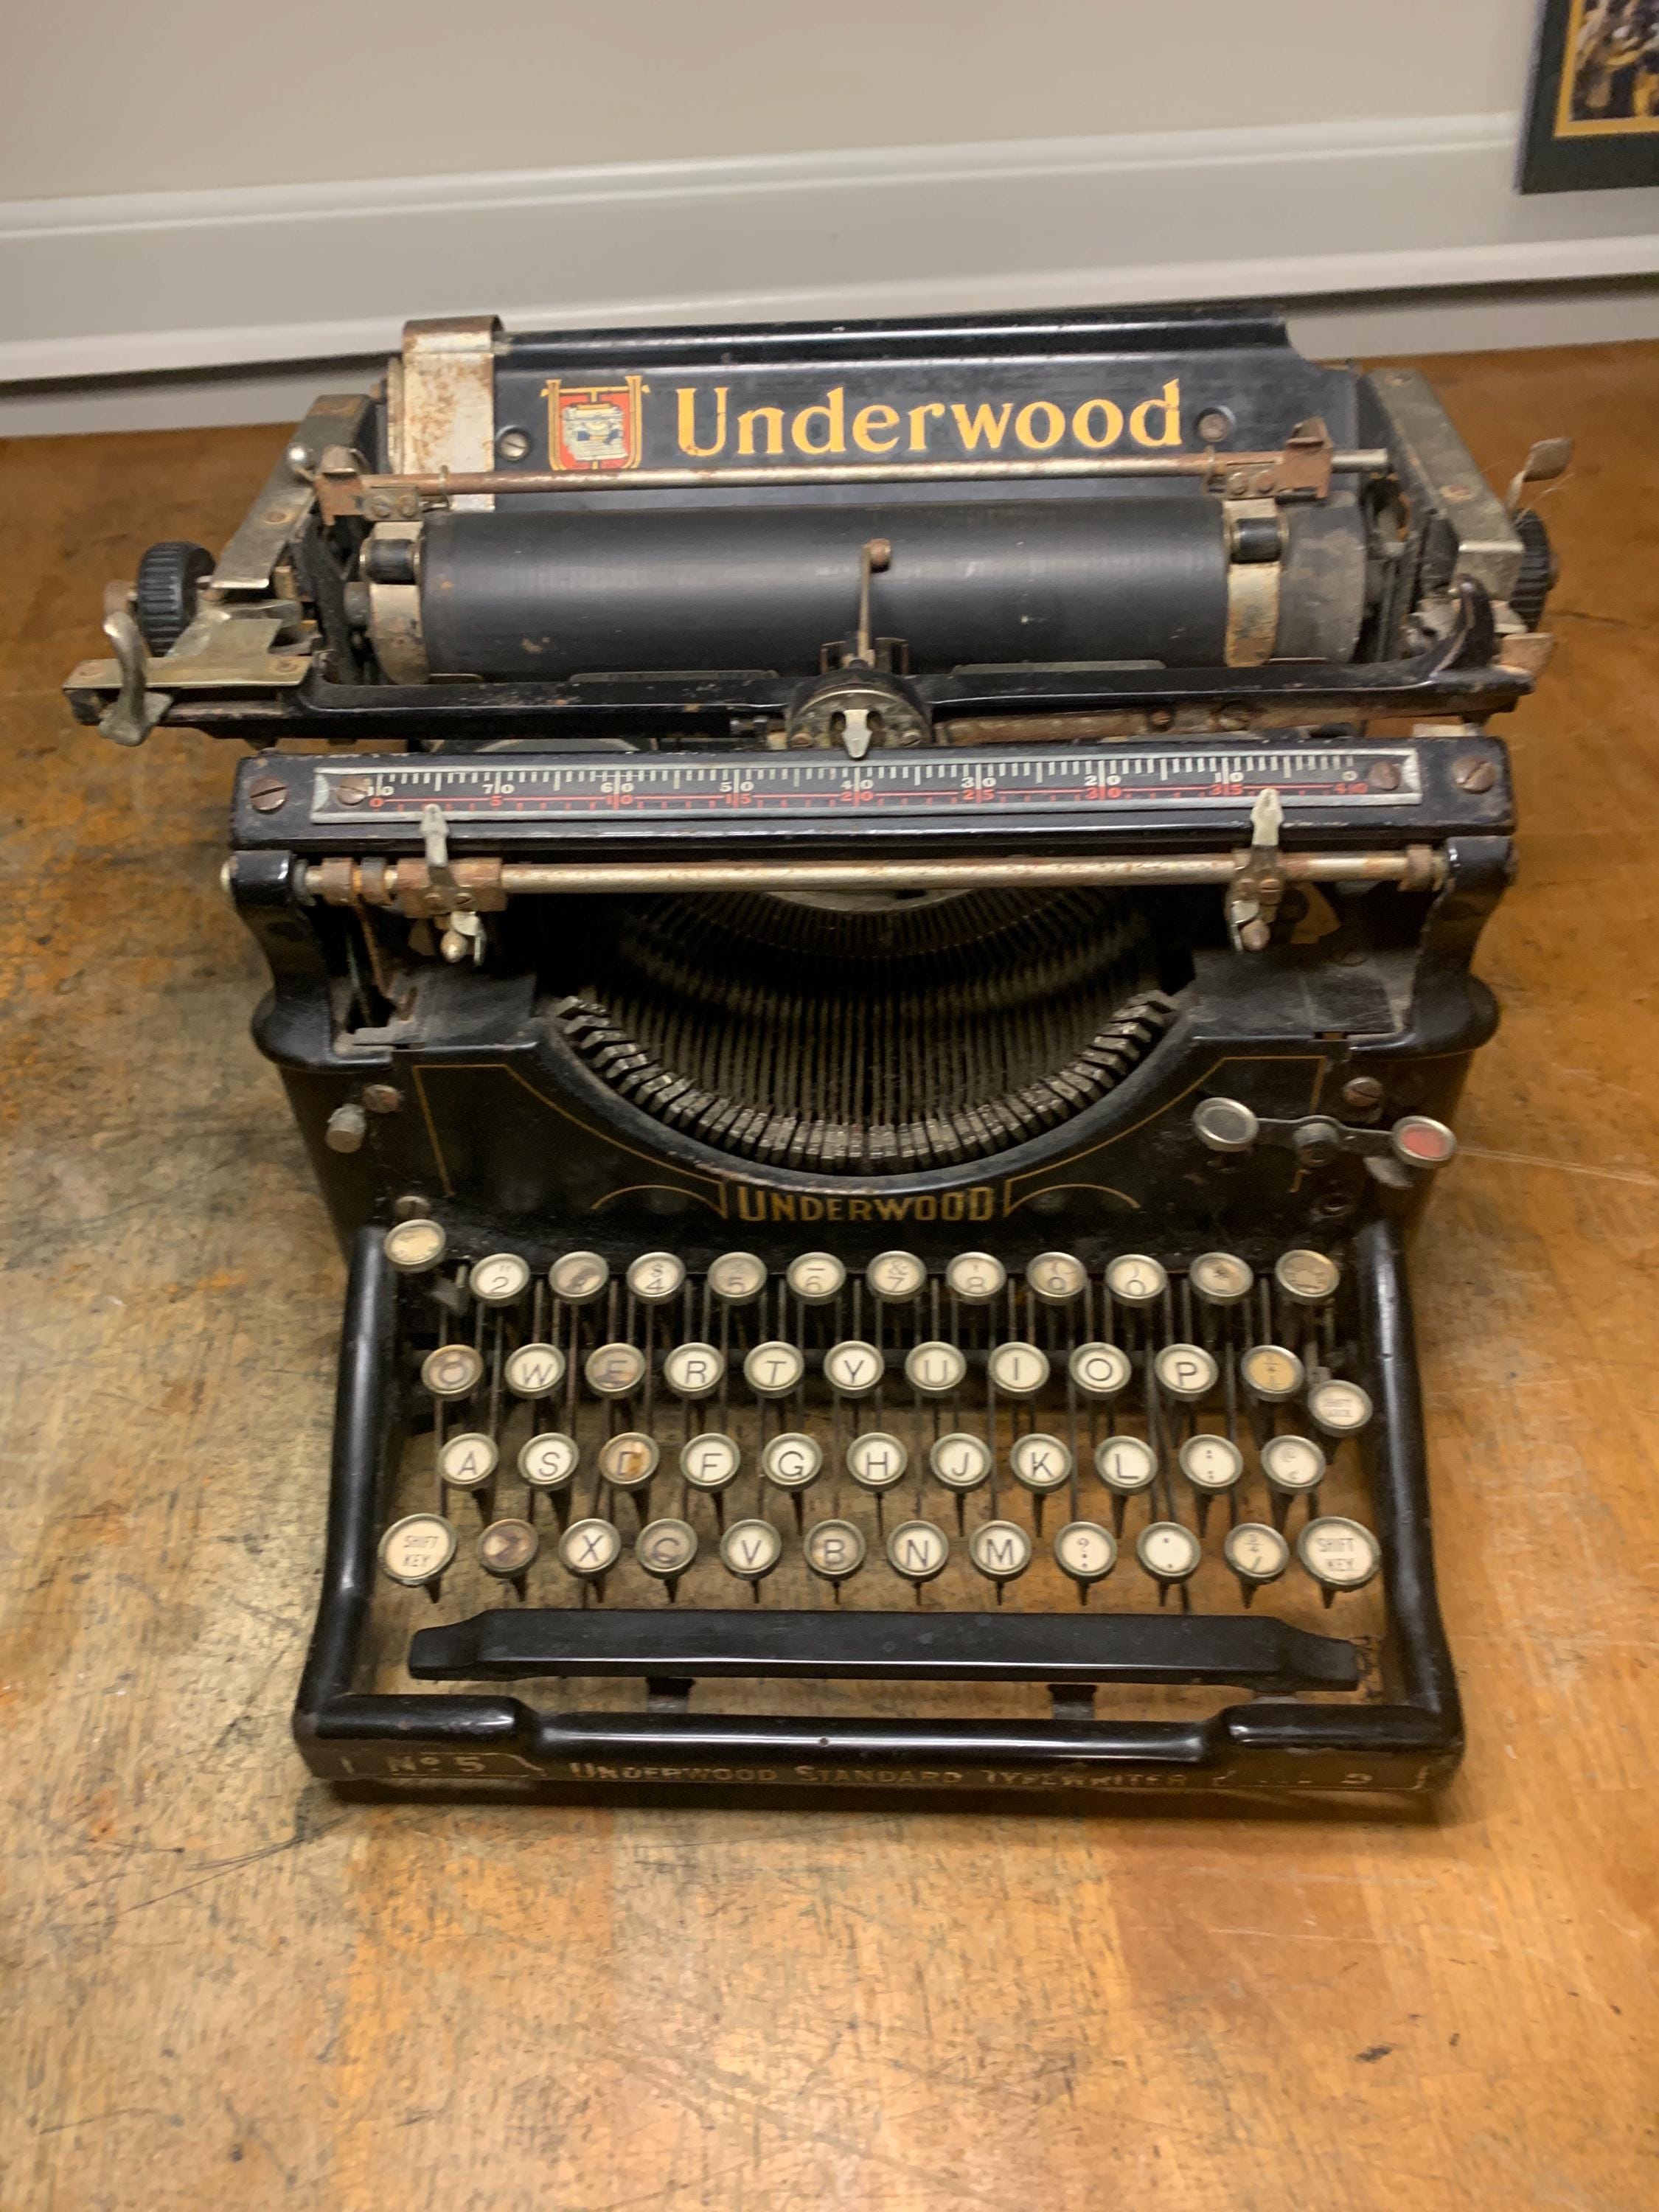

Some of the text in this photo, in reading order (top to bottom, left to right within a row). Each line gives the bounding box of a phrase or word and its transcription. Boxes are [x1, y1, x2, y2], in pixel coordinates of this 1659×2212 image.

[677, 378, 1182, 456] Underwood
[481, 784, 515, 794] 70
[600, 782, 634, 793] 60
[720, 781, 754, 793] 50
[840, 779, 874, 791] 40
[961, 776, 997, 788] 30
[1084, 775, 1121, 786] 20
[840, 790, 874, 801] 20
[962, 789, 995, 801] 25
[1085, 787, 1121, 799] 30
[738, 1185, 995, 1221] UNDERWOOD
[490, 1276, 509, 1293] 2
[645, 1279, 663, 1292] 4
[521, 1364, 553, 1385] W
[685, 1360, 709, 1384] R
[766, 1360, 787, 1384] T
[843, 1360, 865, 1384] Y
[924, 1360, 947, 1384] U
[1085, 1357, 1113, 1382] O
[1175, 1360, 1197, 1387] P
[457, 1450, 478, 1475] A
[538, 1451, 560, 1475] S
[700, 1453, 723, 1478] F
[779, 1450, 804, 1476] G
[866, 1451, 889, 1477] H
[950, 1451, 970, 1476] J
[1032, 1451, 1054, 1477] K
[1115, 1453, 1140, 1479] L
[405, 1534, 439, 1549] SHIFT
[579, 1534, 604, 1562] X
[741, 1539, 762, 1565] V
[824, 1538, 846, 1565] B
[906, 1538, 930, 1568] N
[985, 1538, 1016, 1566] M
[1318, 1537, 1354, 1553] SHIFT
[403, 1553, 429, 1568] KEY
[1325, 1557, 1354, 1572] KEY
[454, 1756, 485, 1773] 5
[794, 1764, 963, 1783] STANDARD
